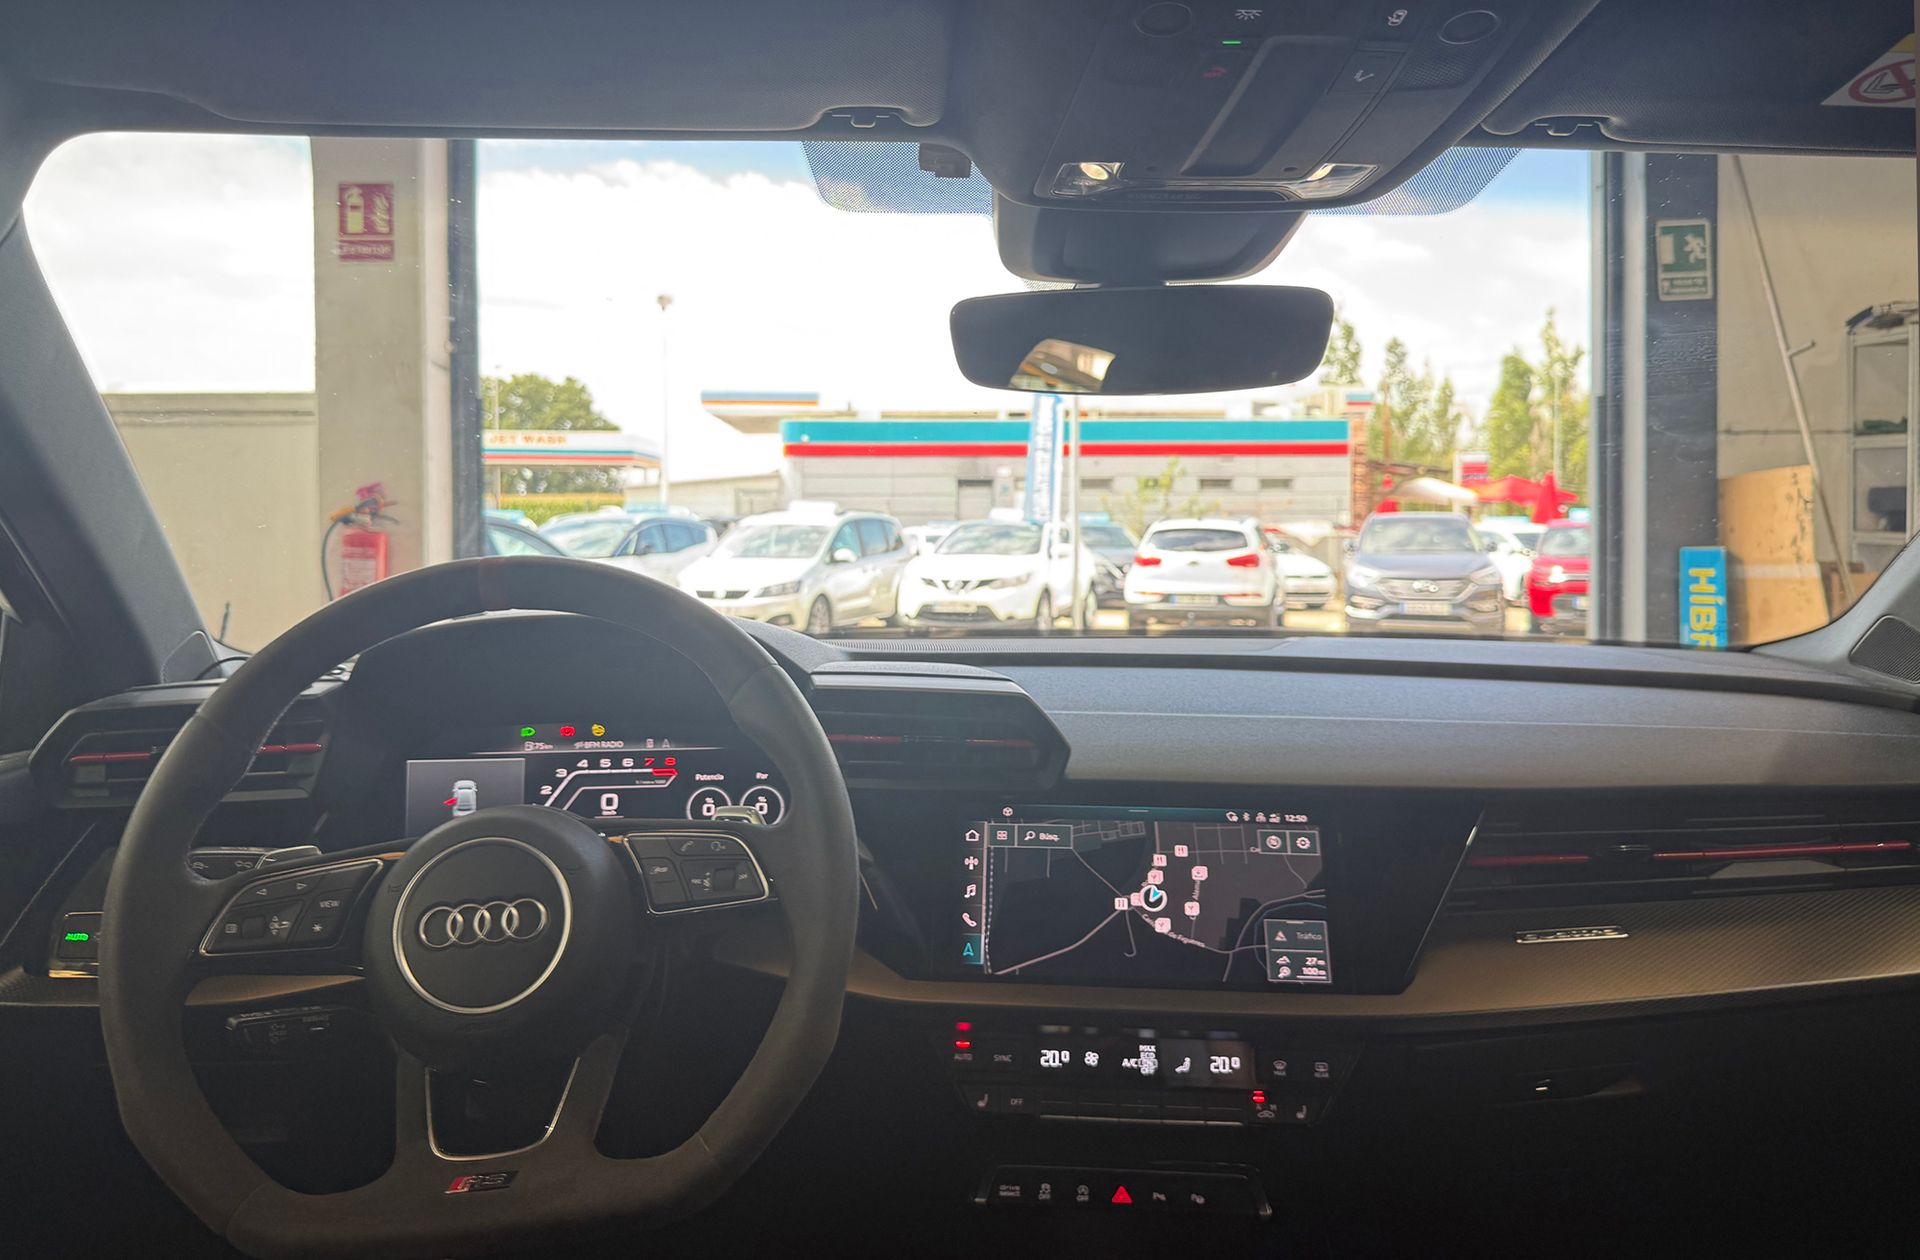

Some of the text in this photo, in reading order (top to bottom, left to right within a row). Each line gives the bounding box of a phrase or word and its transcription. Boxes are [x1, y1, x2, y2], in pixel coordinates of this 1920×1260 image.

[576, 757, 677, 768] 4 5 6 7 8
[555, 768, 568, 778] 3
[539, 785, 553, 795] 2
[600, 792, 619, 811] 0
[702, 803, 716, 816] 0
[755, 802, 769, 815] 0
[1010, 1098, 1024, 1106] OFF
